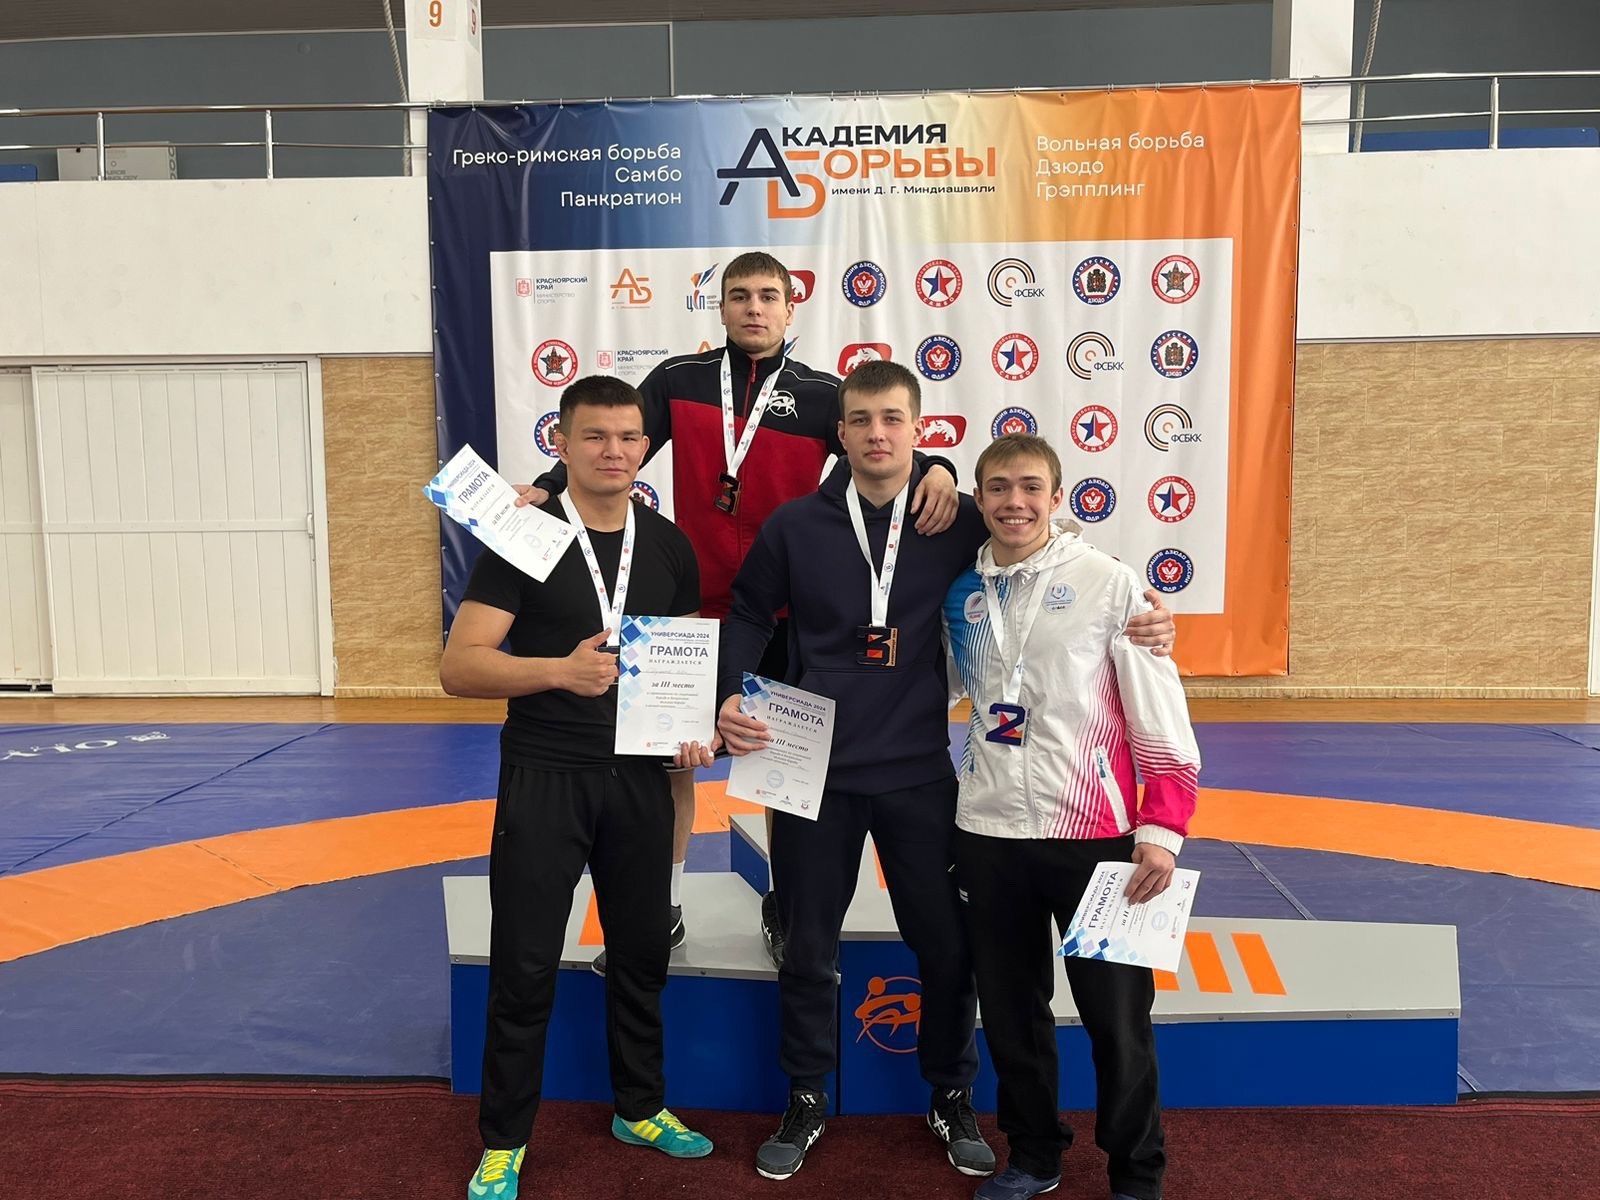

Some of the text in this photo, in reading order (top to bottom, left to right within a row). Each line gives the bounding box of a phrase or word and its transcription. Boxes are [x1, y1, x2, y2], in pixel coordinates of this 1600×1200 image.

[430, 1, 442, 27] 9
[1037, 131, 1205, 153] Вольная борьба
[453, 143, 681, 168] Греко-римская борьба
[717, 124, 946, 206] АКАДЕМИЯ
[615, 165, 682, 183] Самбо
[1036, 159, 1104, 177] Дзюдо
[767, 147, 995, 219] БОРЬБЫ
[832, 185, 995, 195] имени Д. Г. Миндиашвили
[1037, 182, 1146, 201] Грэпплинг
[561, 191, 682, 209] Панкратион
[1014, 288, 1045, 298] ФСБКК
[1094, 361, 1124, 371] ФСБКК
[1171, 433, 1202, 442] ФСБКК
[458, 470, 491, 504] ГРАМОТА
[650, 645, 709, 657] ГРАМОТА
[770, 690, 813, 708] УНИВЕРСИАДА
[813, 703, 826, 712] 2024
[768, 702, 825, 727] ГРАМОТА
[985, 703, 1025, 745] 2
[776, 738, 786, 747] III
[787, 742, 809, 752] место
[1078, 885, 1099, 927] УНИВЕРСИАДА
[1088, 871, 1119, 929] ГРАМОТА
[1122, 910, 1129, 918] II
